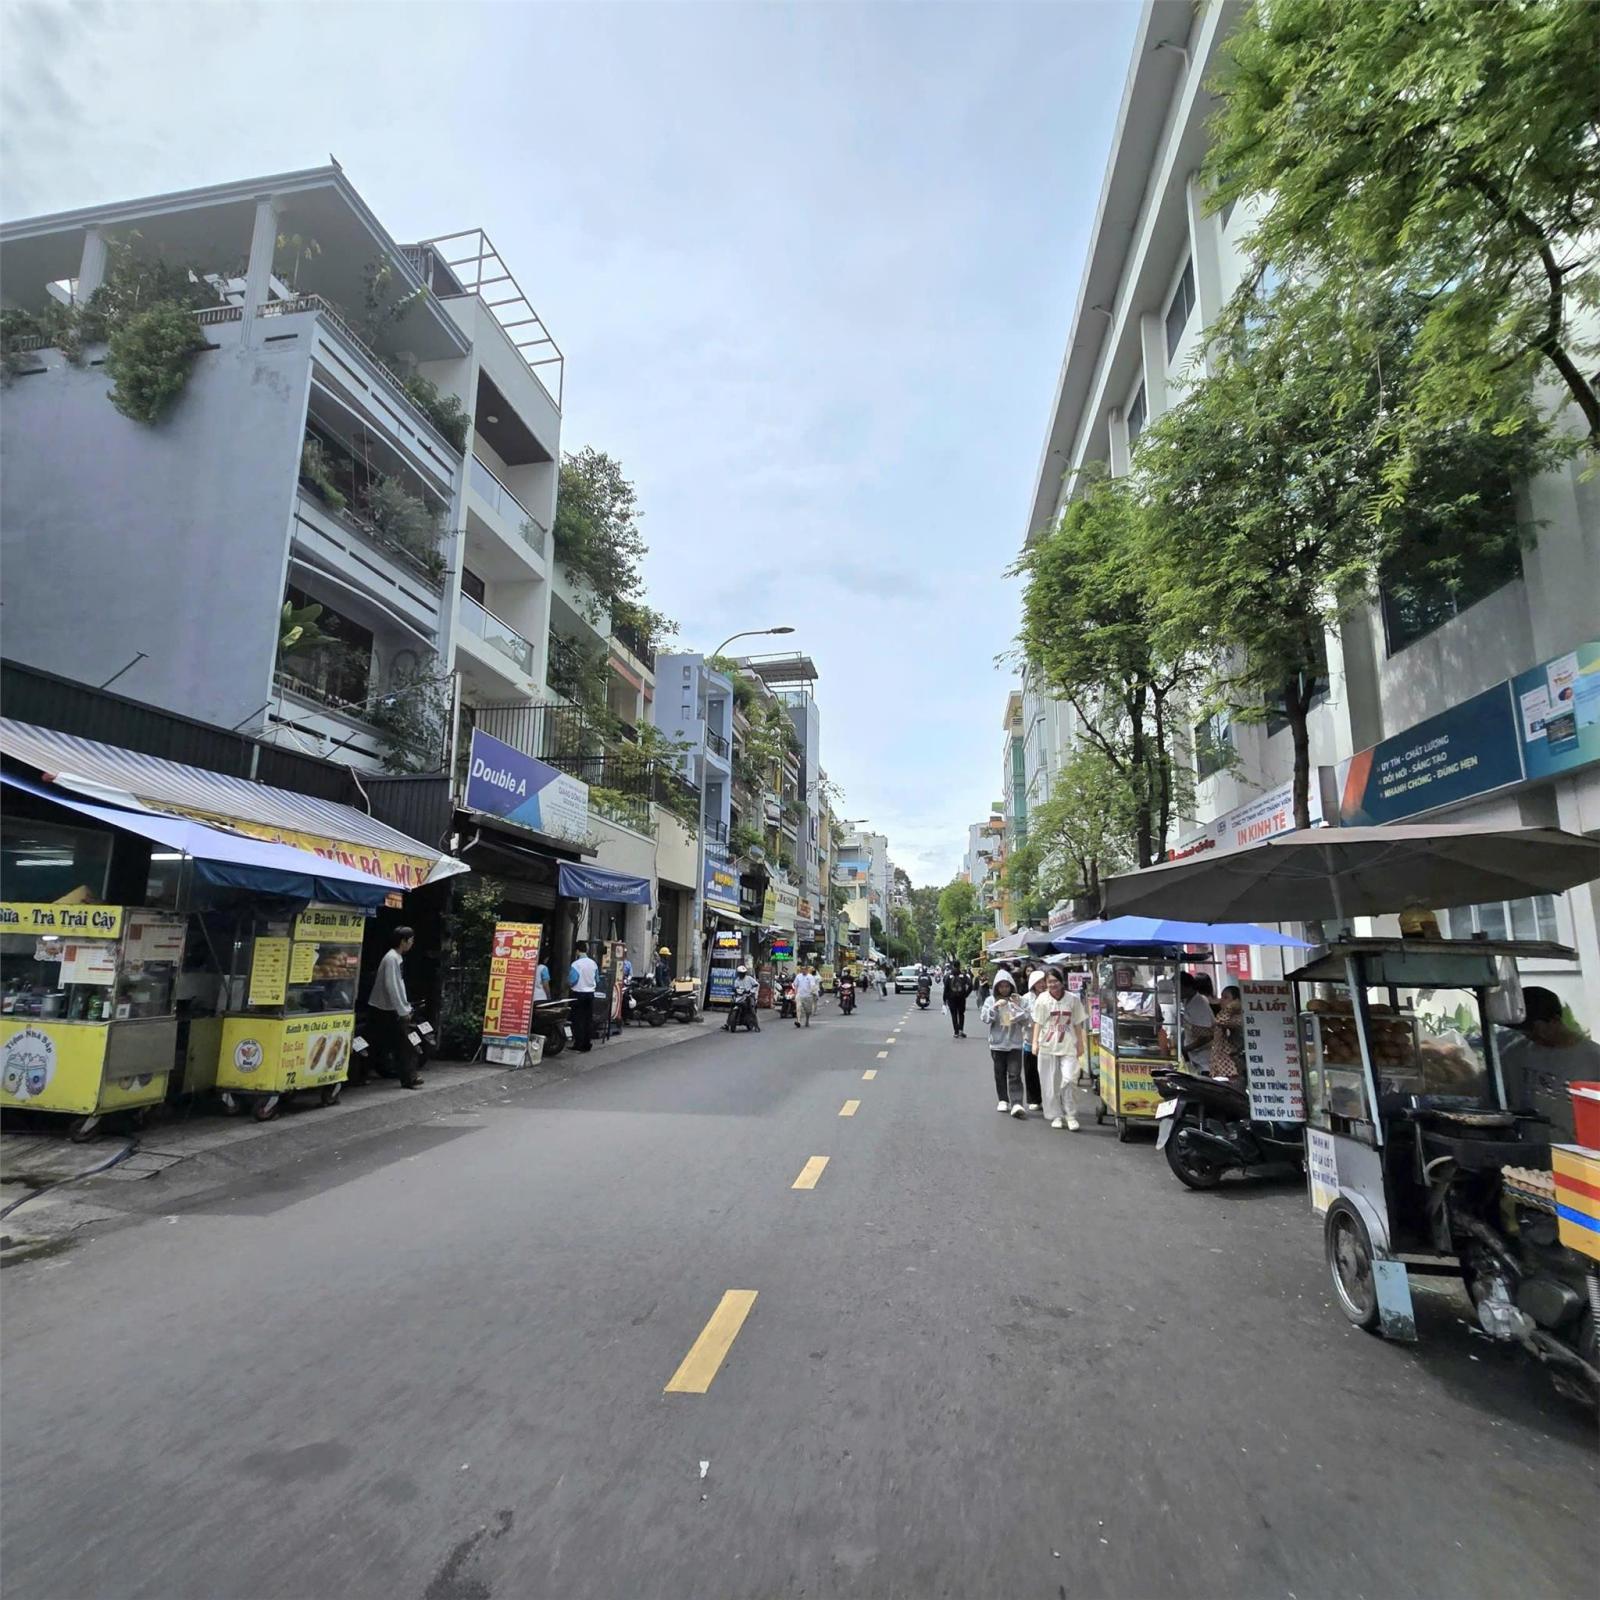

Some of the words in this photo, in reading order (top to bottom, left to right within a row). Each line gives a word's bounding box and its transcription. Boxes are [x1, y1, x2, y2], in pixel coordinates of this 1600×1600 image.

[472, 758, 516, 793] Double
[516, 779, 526, 797] A
[1237, 828, 1248, 846] IN
[1248, 817, 1272, 841] KINH
[1272, 808, 1286, 832] TẾ
[360, 851, 381, 878] BÒ
[32, 909, 55, 925] Trà
[60, 910, 87, 926] Trái
[92, 911, 116, 930] Cây
[300, 912, 312, 925] Xe
[314, 912, 337, 926] Bánh
[352, 916, 362, 927] 72
[1248, 1000, 1264, 1011] LÁ
[1266, 998, 1287, 1011] LỐT
[286, 1071, 297, 1085] 72
